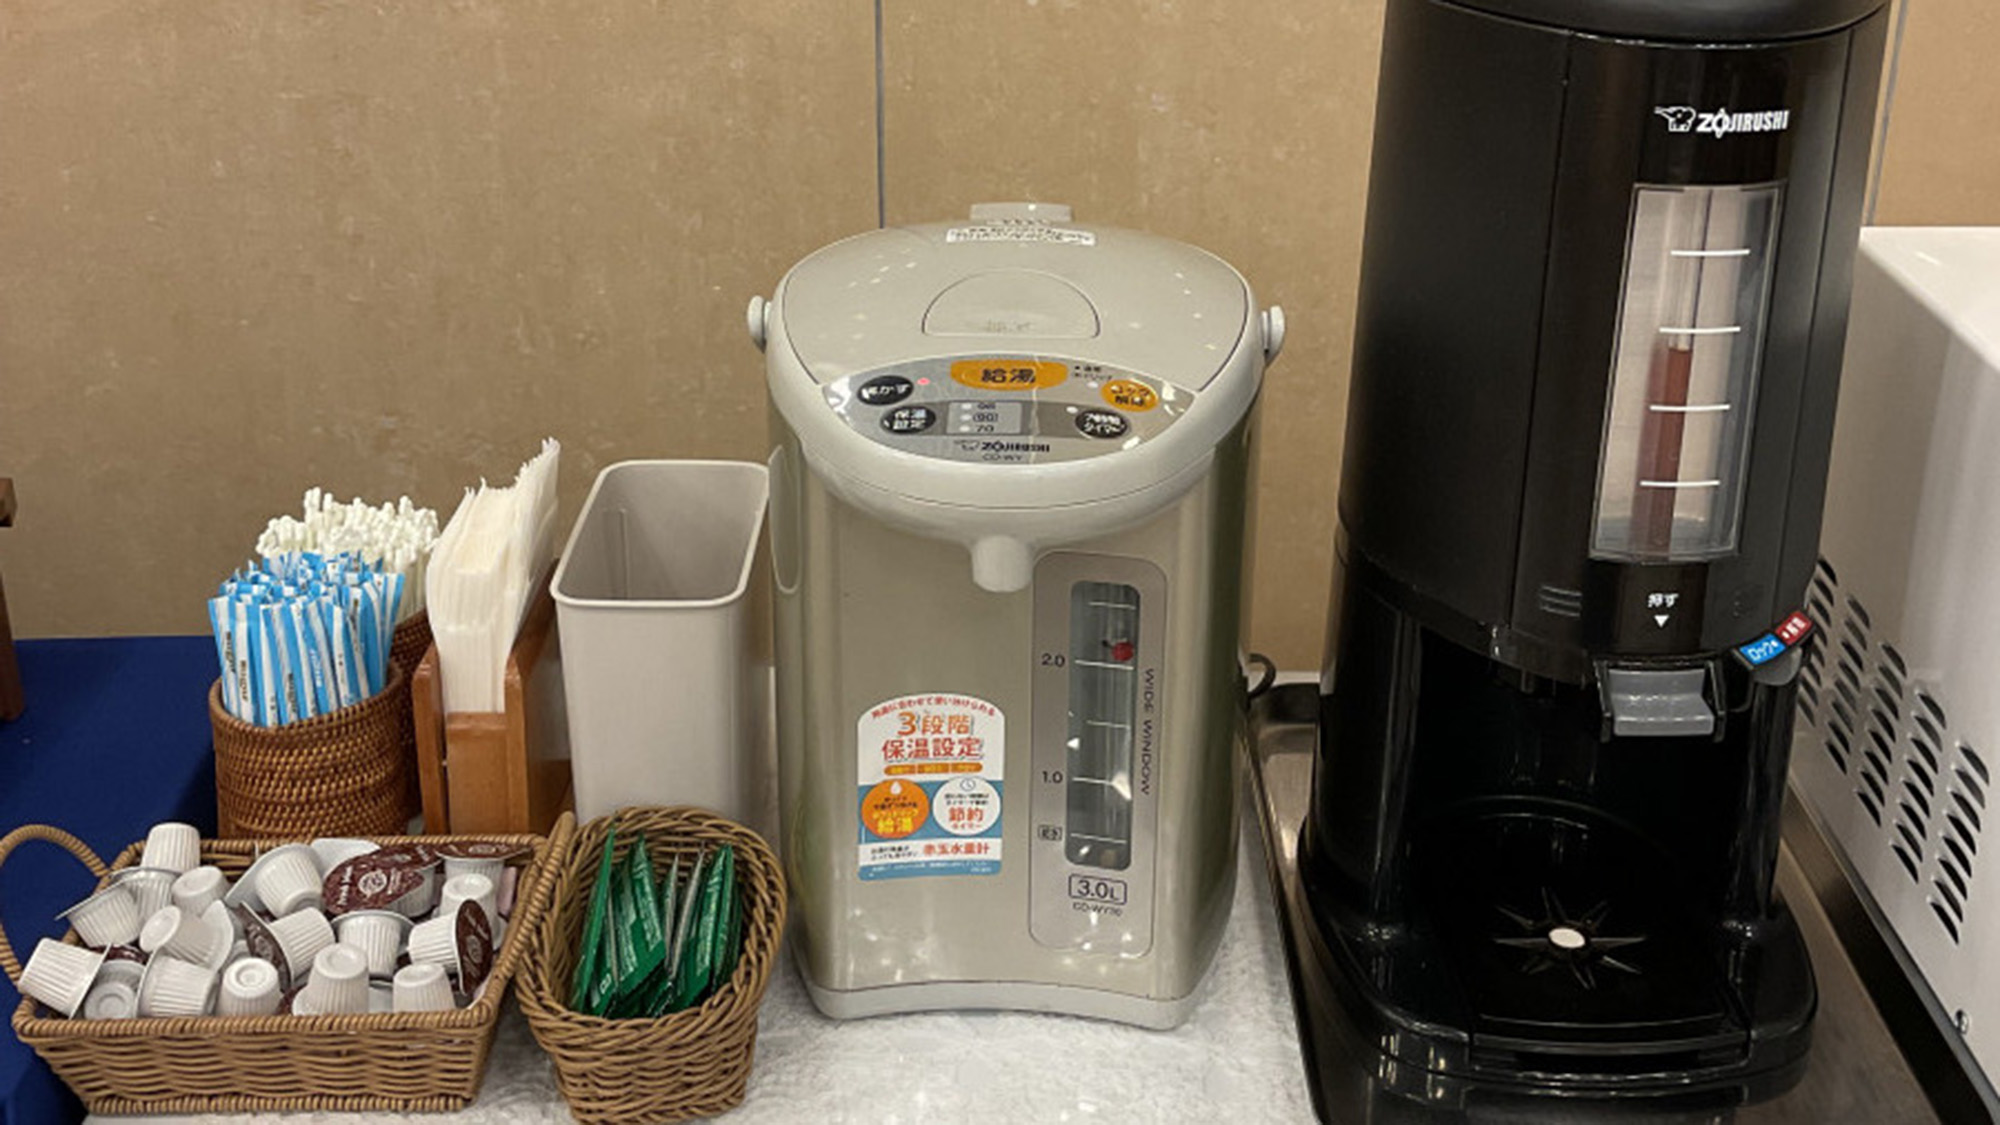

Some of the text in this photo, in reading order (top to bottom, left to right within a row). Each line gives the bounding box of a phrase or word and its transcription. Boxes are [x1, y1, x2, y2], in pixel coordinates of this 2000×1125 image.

[982, 368, 1036, 384] 給湯
[975, 424, 995, 432] 70
[1648, 593, 1680, 608] 押す
[1747, 640, 1775, 662] ロック
[1042, 653, 1066, 668] 2.0
[897, 710, 972, 737] 3段階
[1141, 668, 1155, 796] WIDE WINDOW
[882, 737, 984, 762] 保温設定
[1041, 771, 1063, 784] 1.0
[949, 807, 984, 822] 節約
[923, 842, 990, 856] 赤玉水量計
[1077, 879, 1121, 902] 3.0L
